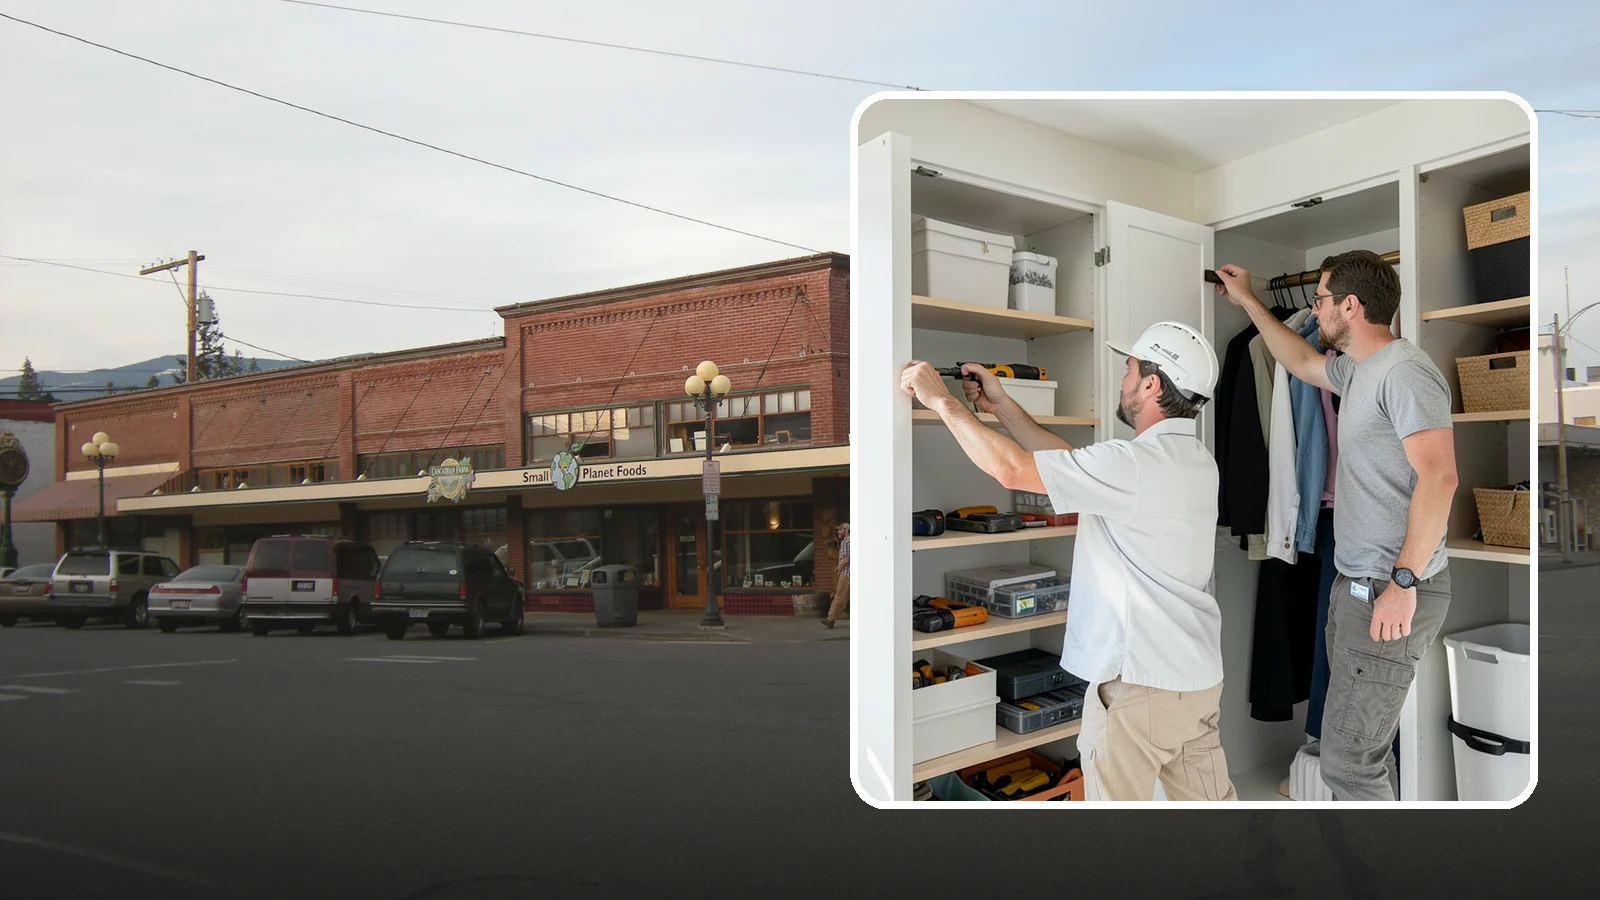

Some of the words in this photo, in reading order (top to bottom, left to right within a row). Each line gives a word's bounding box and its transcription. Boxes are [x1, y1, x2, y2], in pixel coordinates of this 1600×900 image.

[523, 471, 549, 483] Small
[583, 467, 614, 479] Planet
[617, 464, 647, 477] Foods
